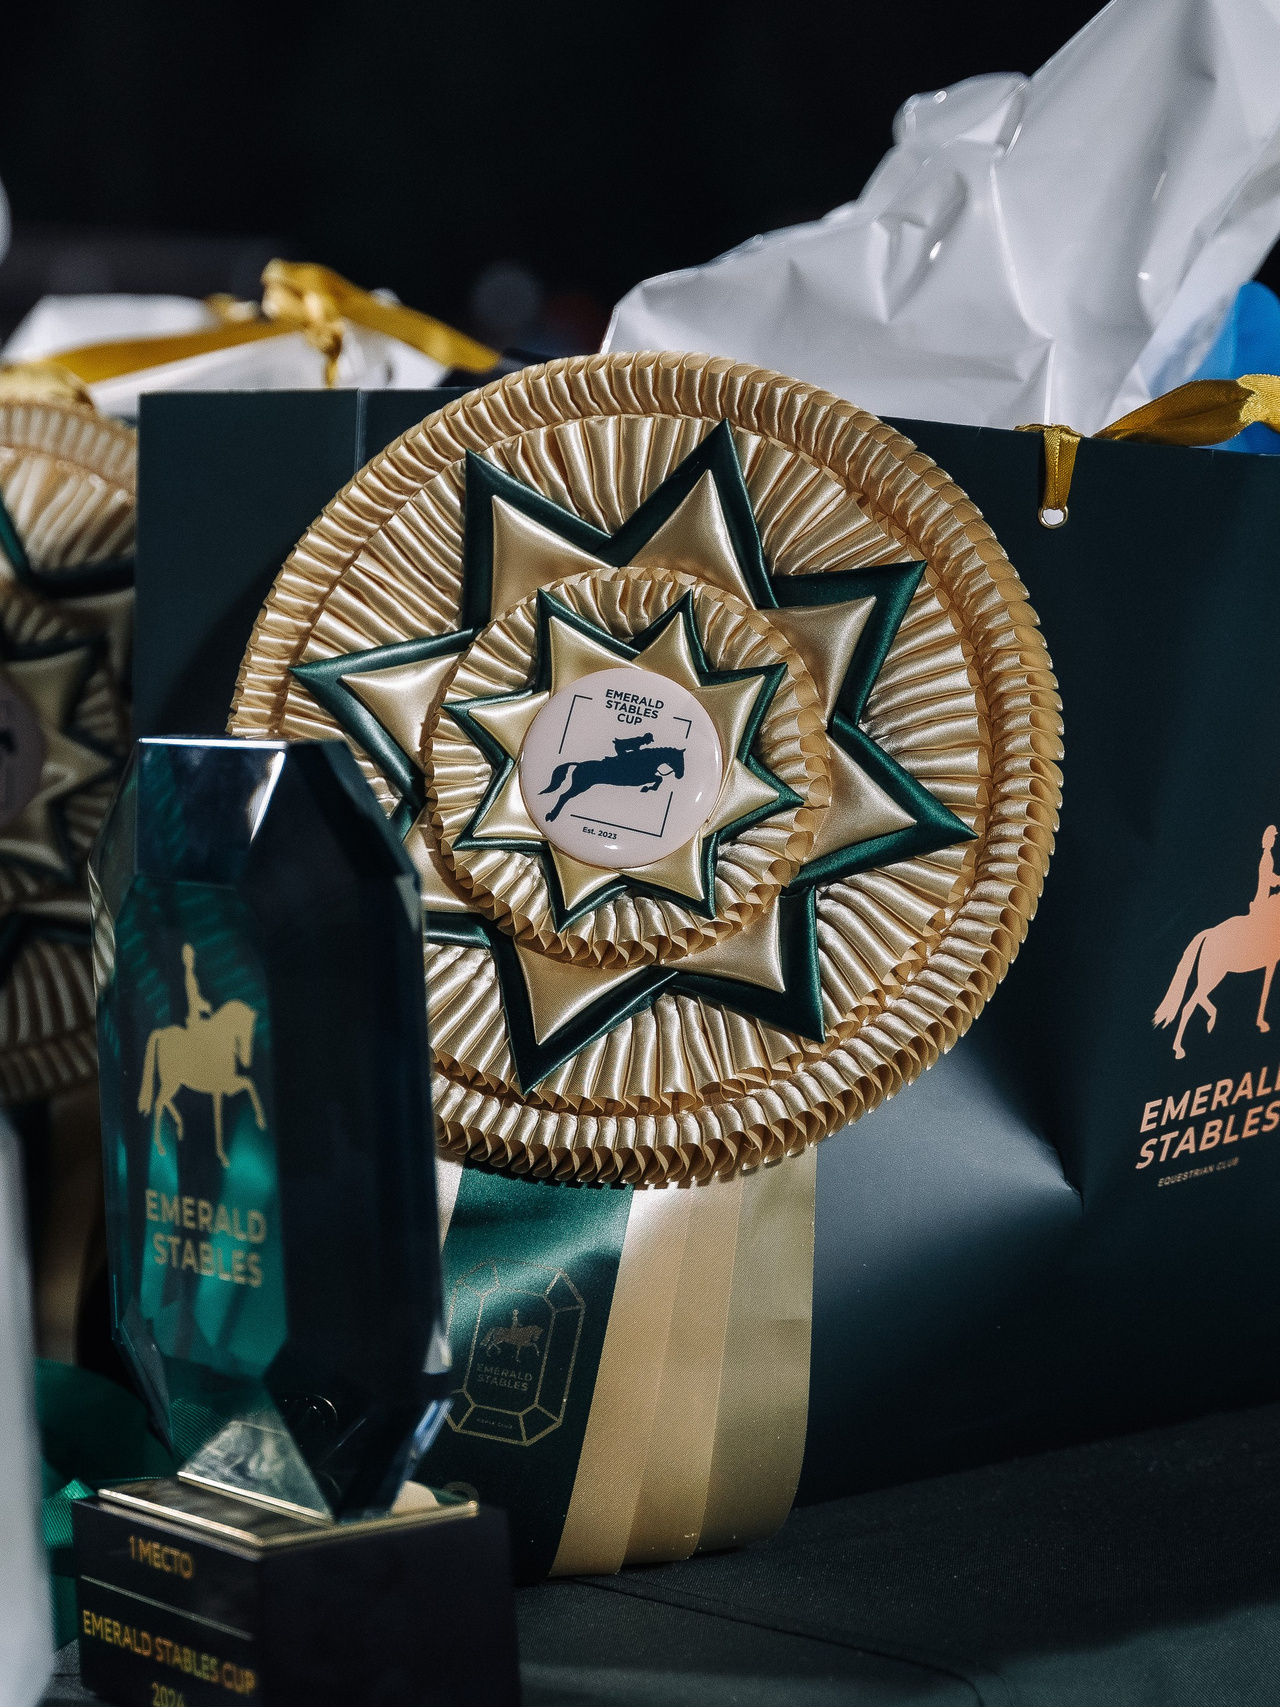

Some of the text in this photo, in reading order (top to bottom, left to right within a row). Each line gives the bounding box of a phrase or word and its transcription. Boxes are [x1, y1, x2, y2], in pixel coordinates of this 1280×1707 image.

[605, 688, 665, 710] EMERALD
[605, 699, 659, 719] STABLES
[617, 713, 642, 726] CUP
[582, 826, 617, 840] Est. 2023
[1134, 1100, 1280, 1170] STABLES
[1157, 1157, 1239, 1187] EQUESTRIAN CLUB
[144, 1188, 267, 1244] EMERALD
[153, 1232, 263, 1288] STABLES
[476, 1363, 533, 1382] EMERALD
[476, 1374, 529, 1392] STABLES
[129, 1536, 194, 1580] 1 МЕСТО
[82, 1609, 257, 1695] EMERALD STABLES CUP
